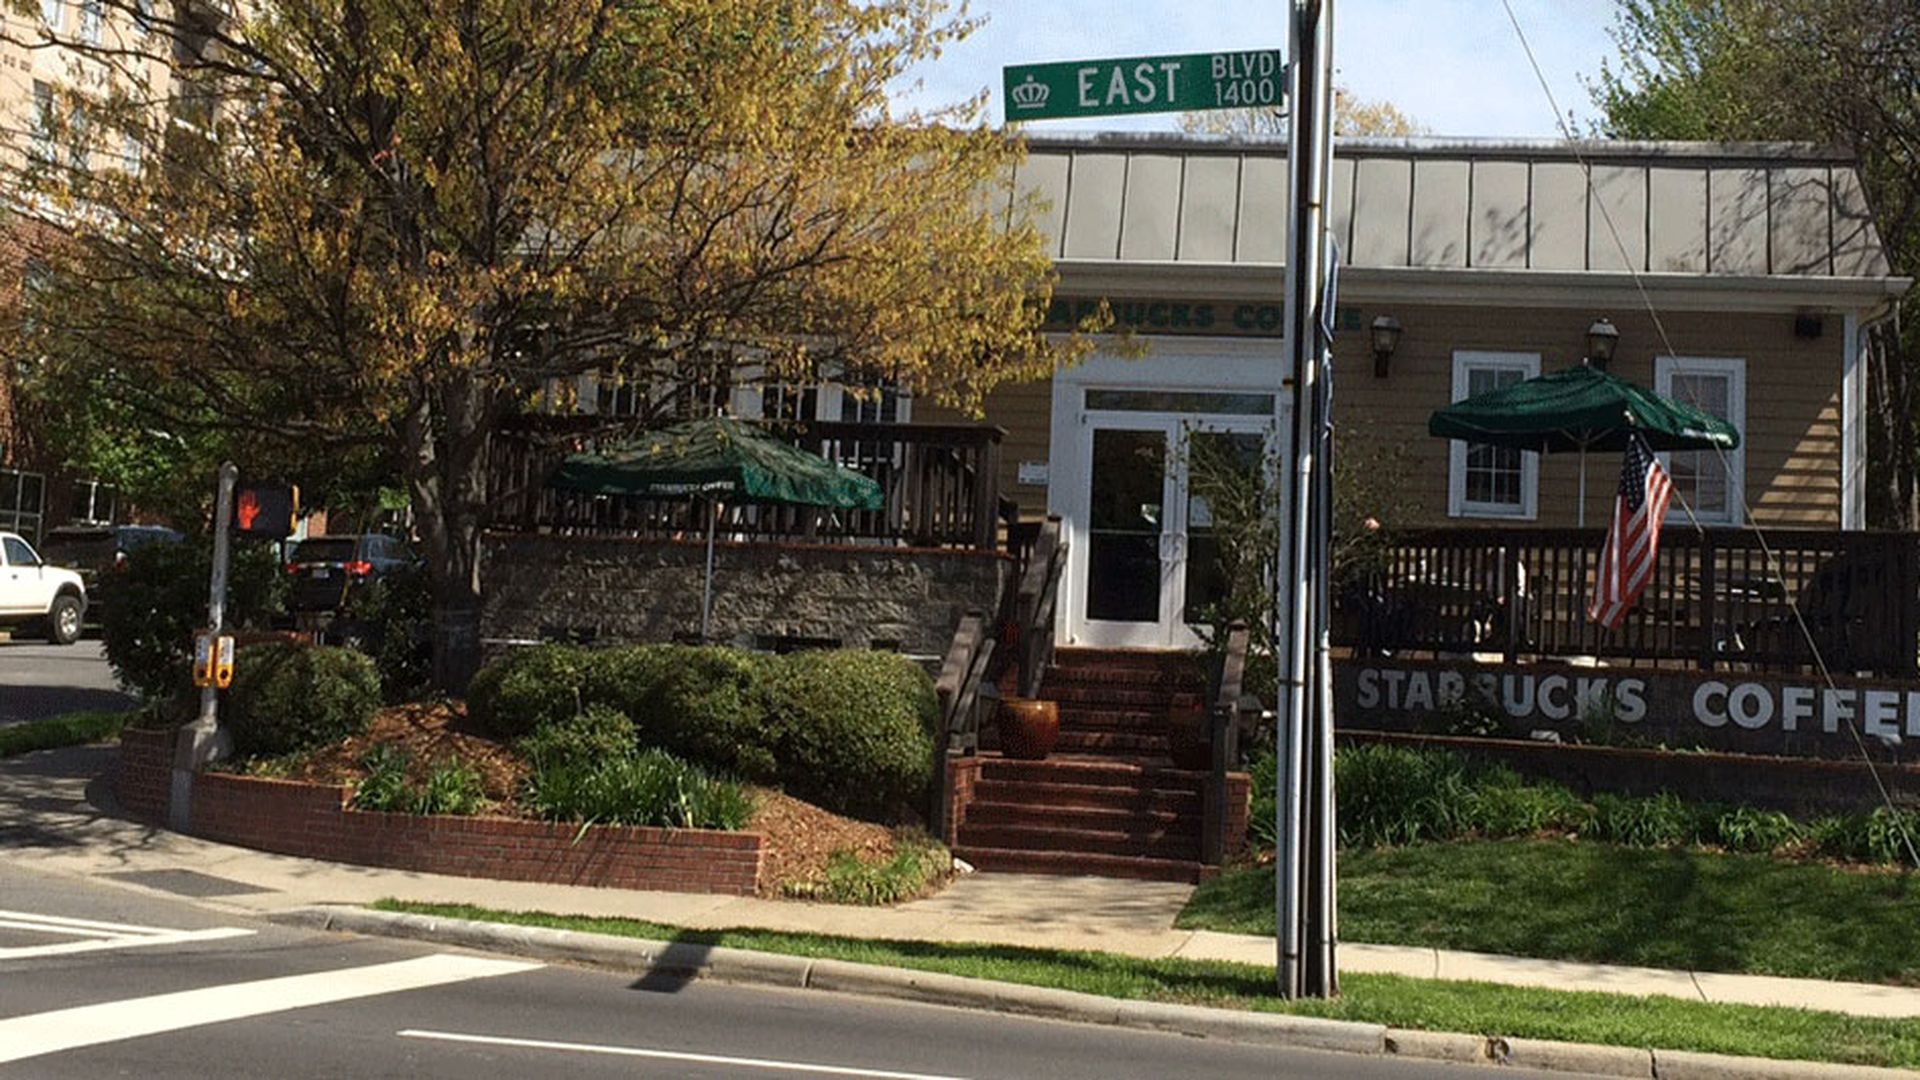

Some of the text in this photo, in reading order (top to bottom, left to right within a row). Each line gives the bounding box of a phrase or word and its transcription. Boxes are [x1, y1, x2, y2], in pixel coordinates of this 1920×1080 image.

[1077, 52, 1275, 107] EAST BLVD
[1214, 79, 1275, 107] 1400
